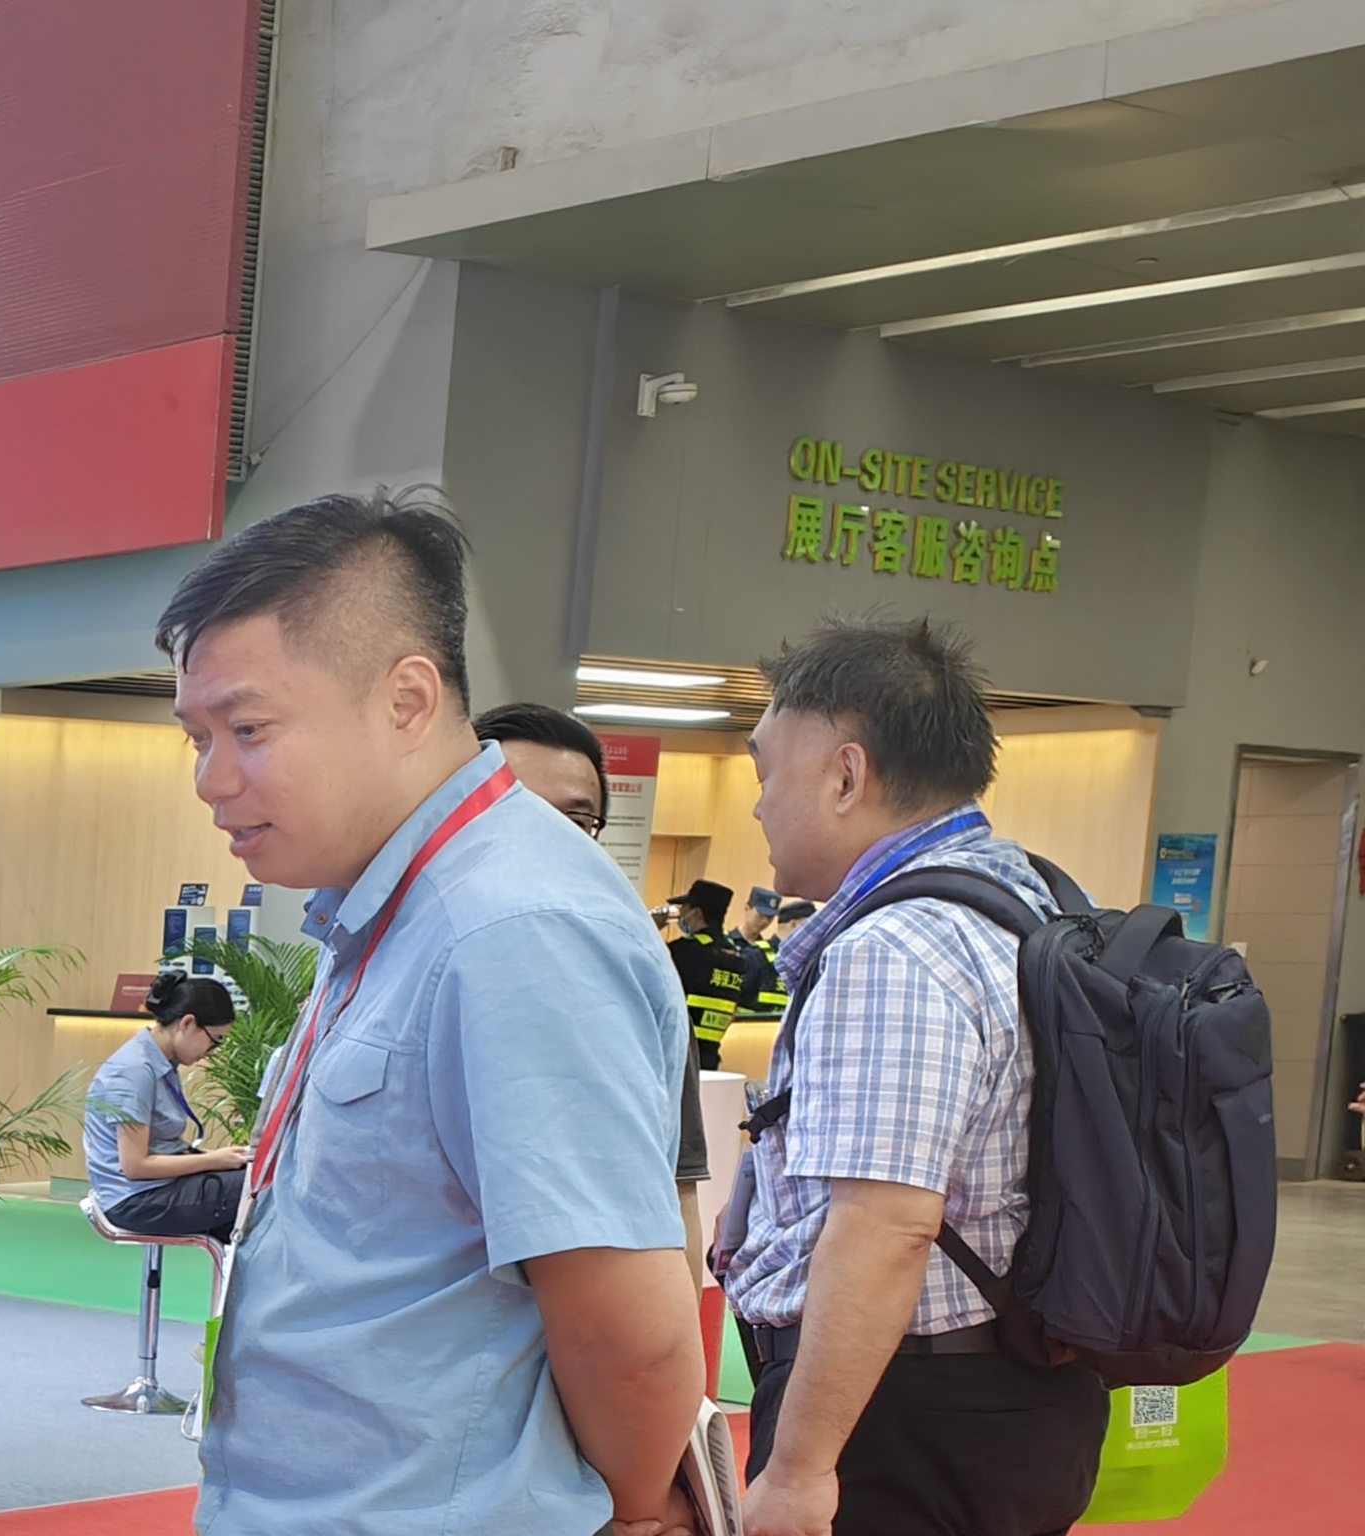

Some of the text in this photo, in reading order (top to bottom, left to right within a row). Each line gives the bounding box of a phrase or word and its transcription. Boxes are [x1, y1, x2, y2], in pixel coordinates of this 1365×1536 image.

[789, 436, 1065, 519] ON-SITE SERVICE
[781, 494, 1062, 592] 展厅客服咨询点
